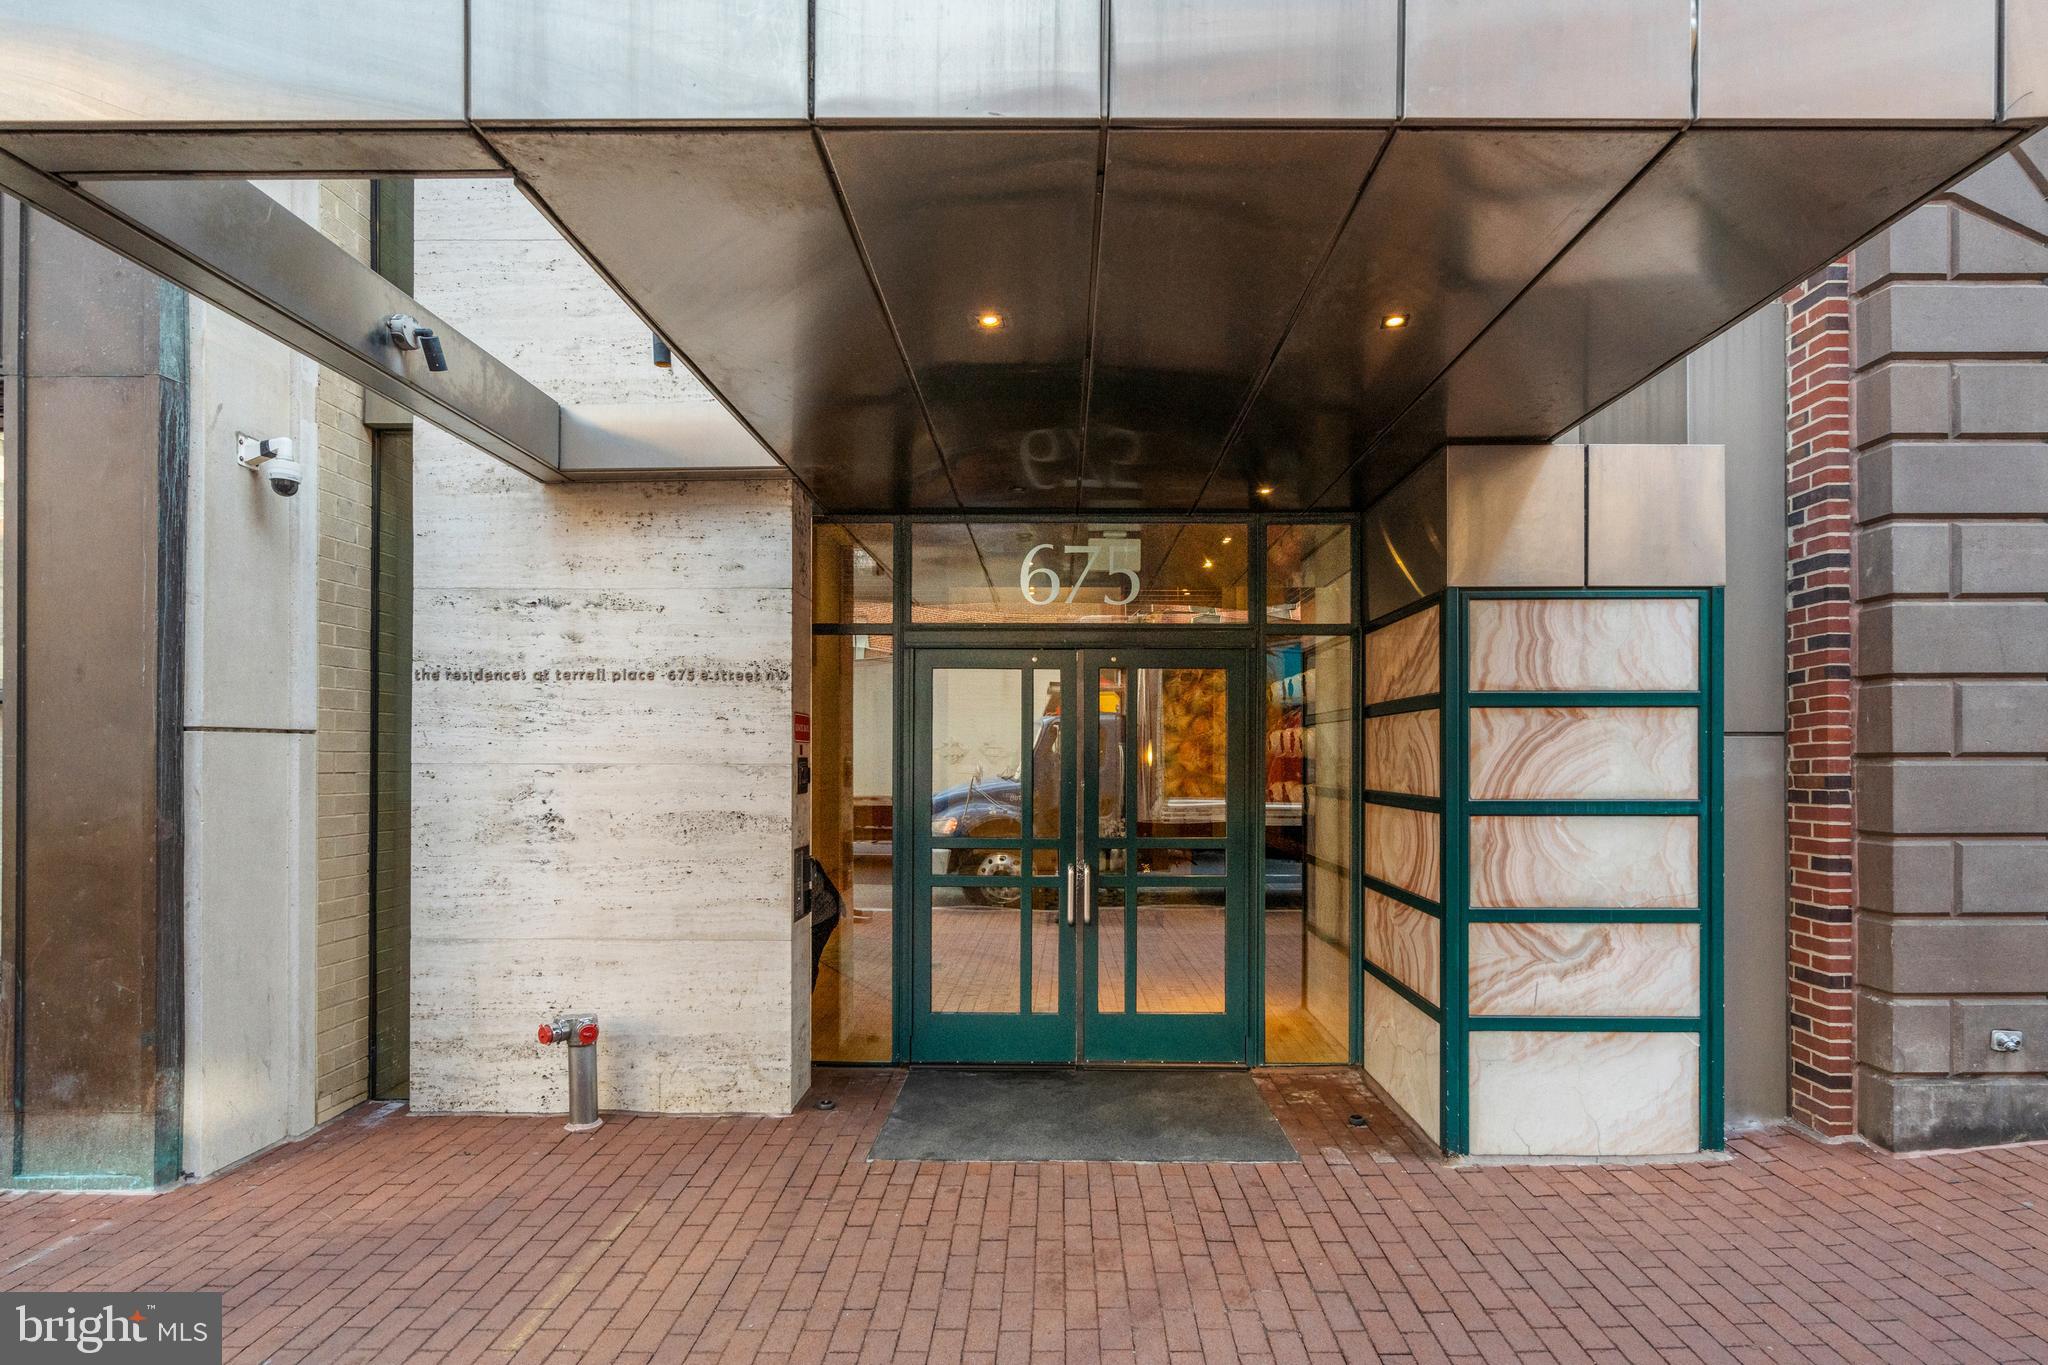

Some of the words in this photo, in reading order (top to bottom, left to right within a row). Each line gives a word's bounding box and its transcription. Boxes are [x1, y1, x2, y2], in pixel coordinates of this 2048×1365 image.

[1020, 543, 1140, 606] 675
[414, 668, 441, 682] the
[446, 668, 527, 682] residences
[533, 669, 550, 682] at
[555, 669, 606, 682] terrell
[612, 669, 655, 683] place
[667, 669, 696, 682] 675
[713, 669, 761, 682] street
